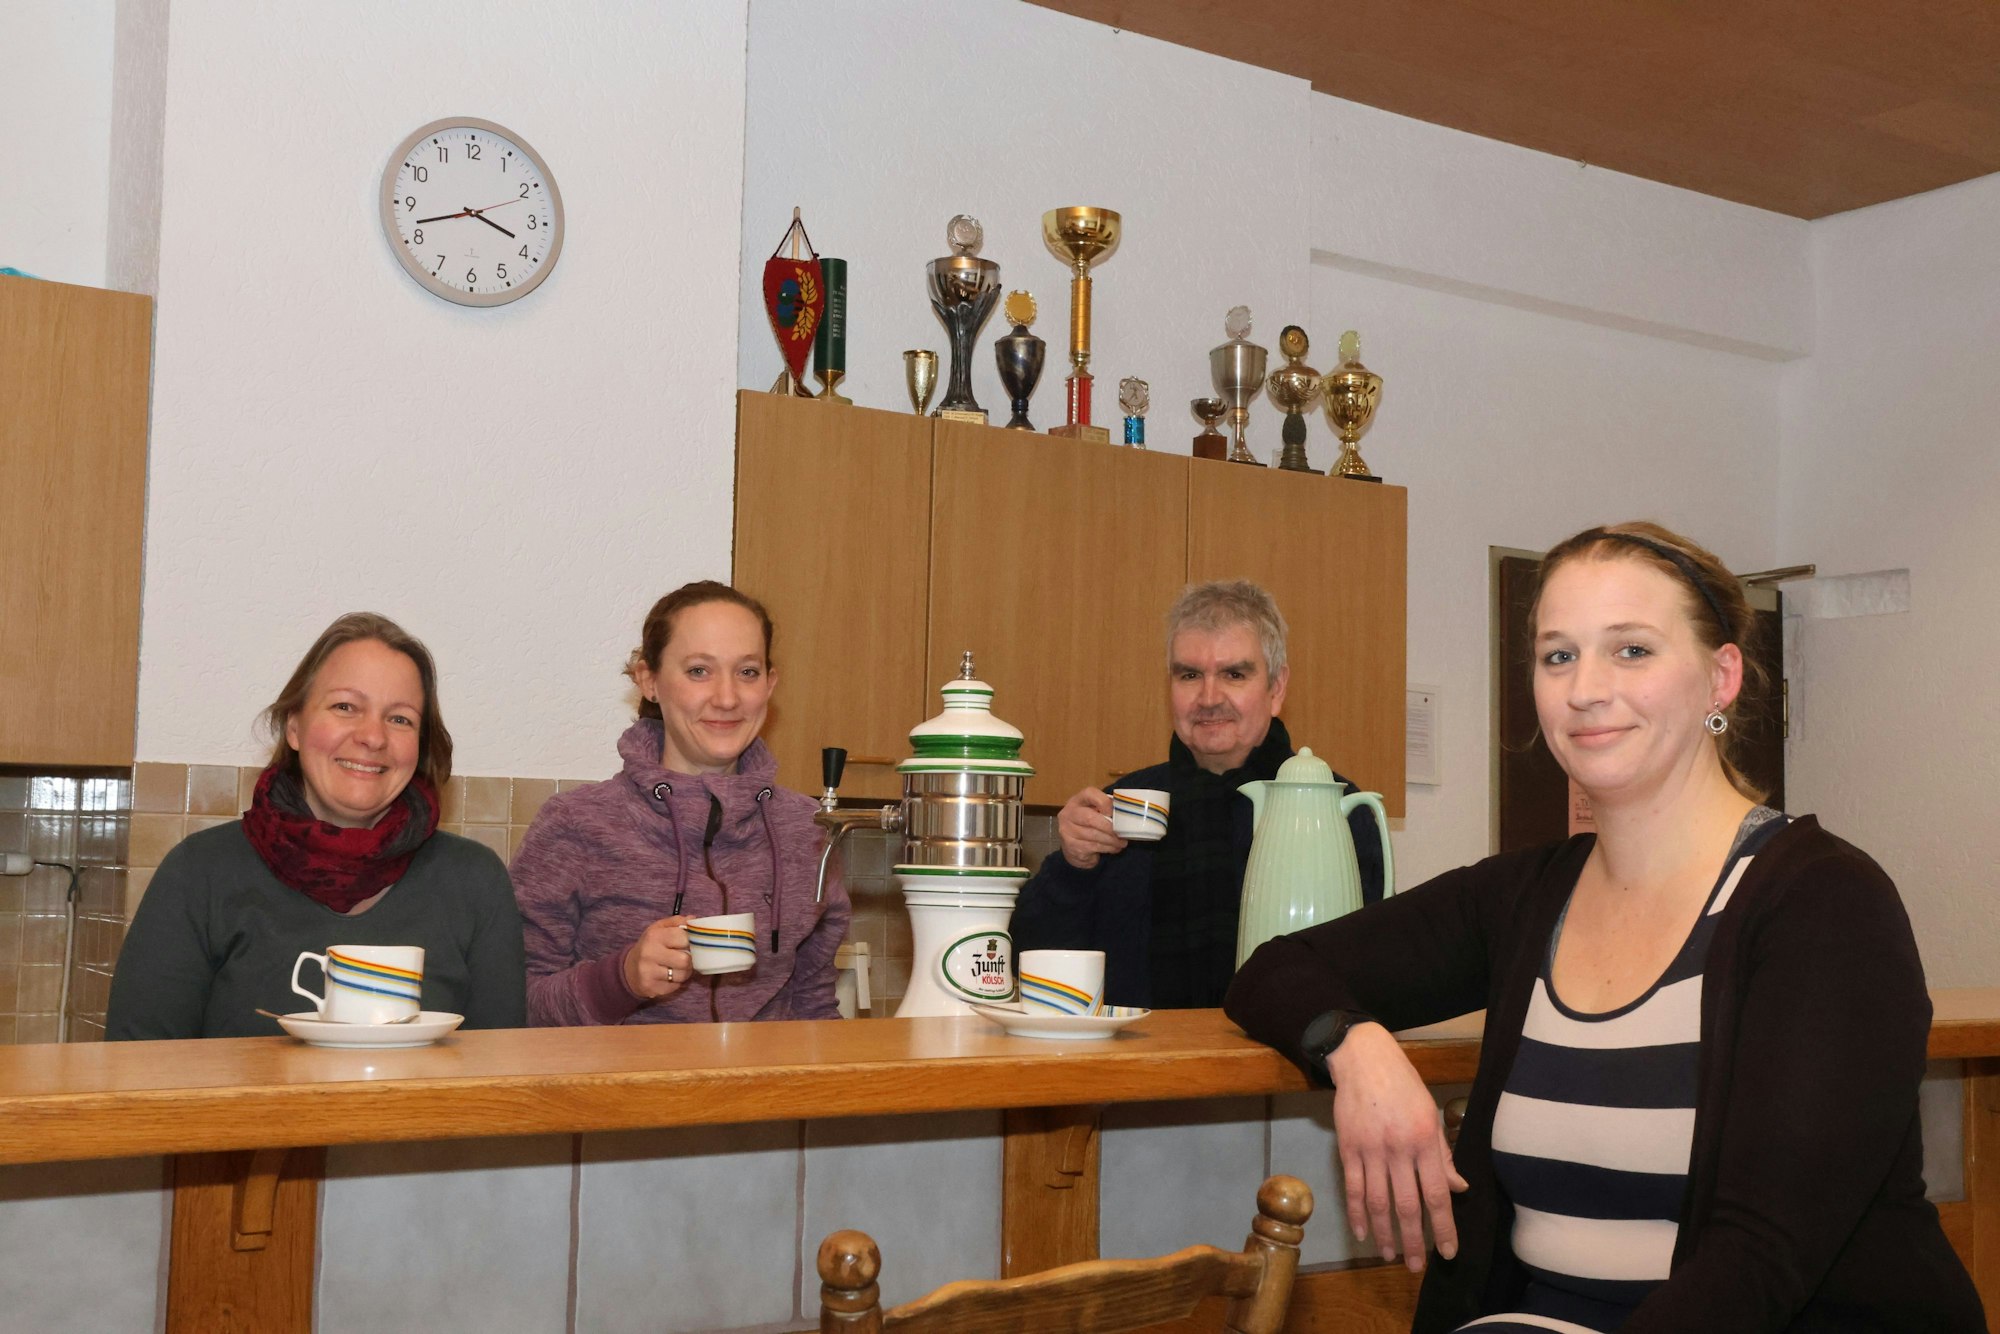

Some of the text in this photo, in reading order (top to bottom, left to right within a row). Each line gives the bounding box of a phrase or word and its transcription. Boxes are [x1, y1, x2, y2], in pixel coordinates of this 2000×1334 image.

[437, 146, 448, 163] 11
[465, 143, 481, 160] 12
[500, 157, 506, 173] 1
[412, 165, 428, 182] 10
[519, 182, 530, 199] 2
[405, 196, 416, 212] 9
[527, 214, 537, 230] 3
[413, 228, 424, 245] 8
[518, 244, 529, 260] 4
[436, 254, 446, 270] 7
[466, 267, 477, 283] 6
[496, 263, 507, 279] 5
[971, 954, 1005, 977] Zunft
[982, 974, 1004, 985] KÖLSCH
